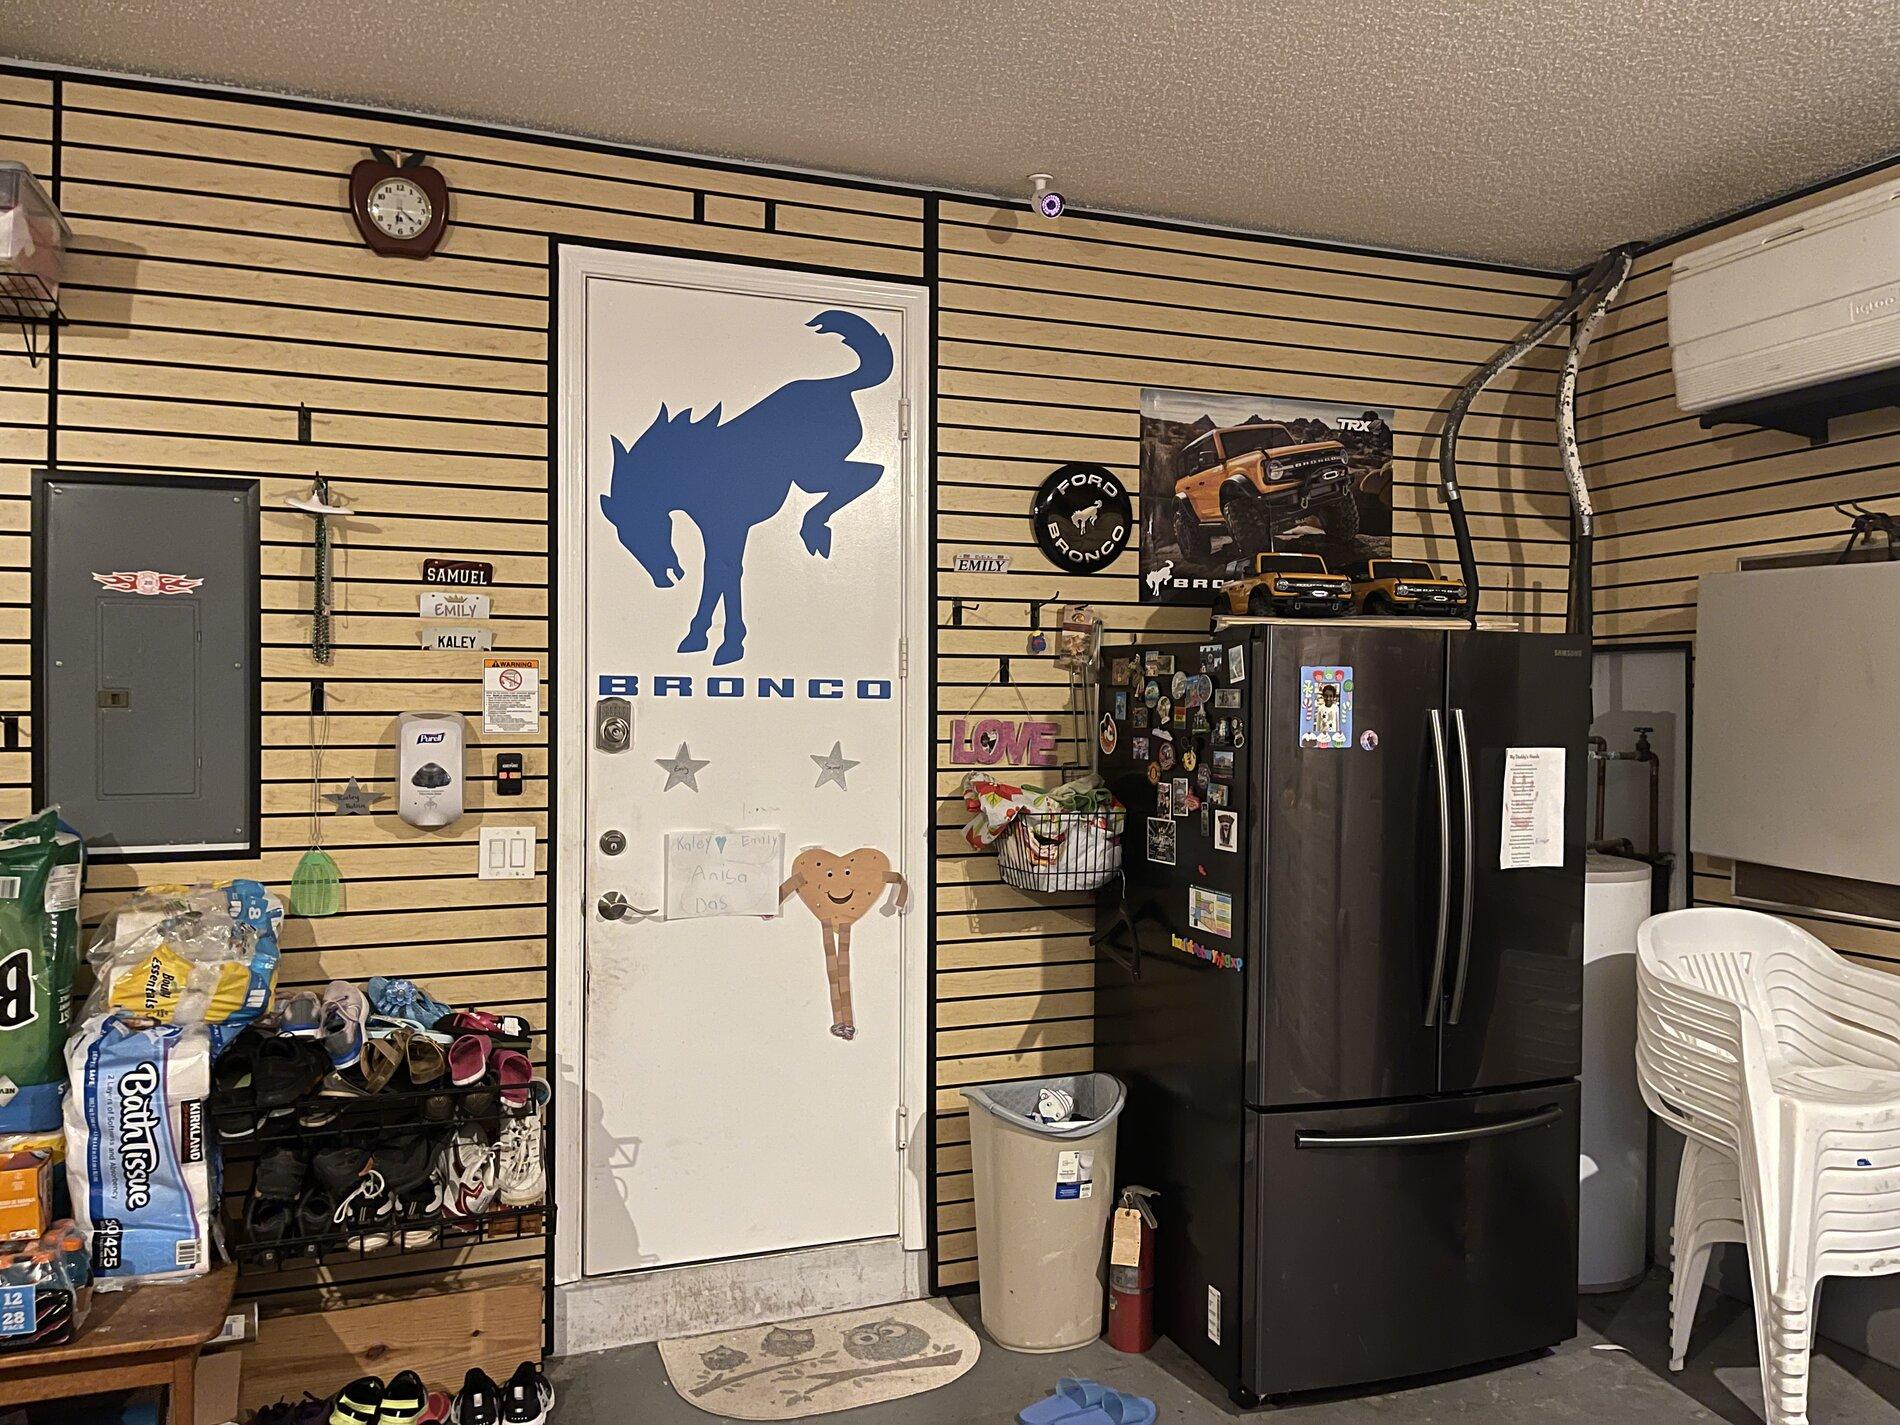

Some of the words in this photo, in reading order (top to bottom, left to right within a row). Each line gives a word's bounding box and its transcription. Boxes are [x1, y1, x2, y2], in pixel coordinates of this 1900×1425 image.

[1057, 473, 1118, 498] FORD
[1047, 522, 1124, 563] BRONCO
[958, 559, 1006, 572] EMILY
[427, 567, 487, 585] SAMUEL
[1173, 578, 1225, 589] BRO
[434, 603, 477, 618] EMILY
[438, 635, 476, 649] KALEY
[599, 675, 891, 699] BRONCO
[950, 718, 1058, 766] LOVE
[145, 956, 163, 1009] Essentials
[88, 1069, 96, 1086] SAFE
[107, 1106, 115, 1114] of
[189, 1102, 201, 1160] KIRKLAND
[110, 1162, 119, 1200] Absorbency
[103, 1237, 118, 1267] 425
[4, 1292, 23, 1306] 12
[2, 1311, 25, 1325] 28
